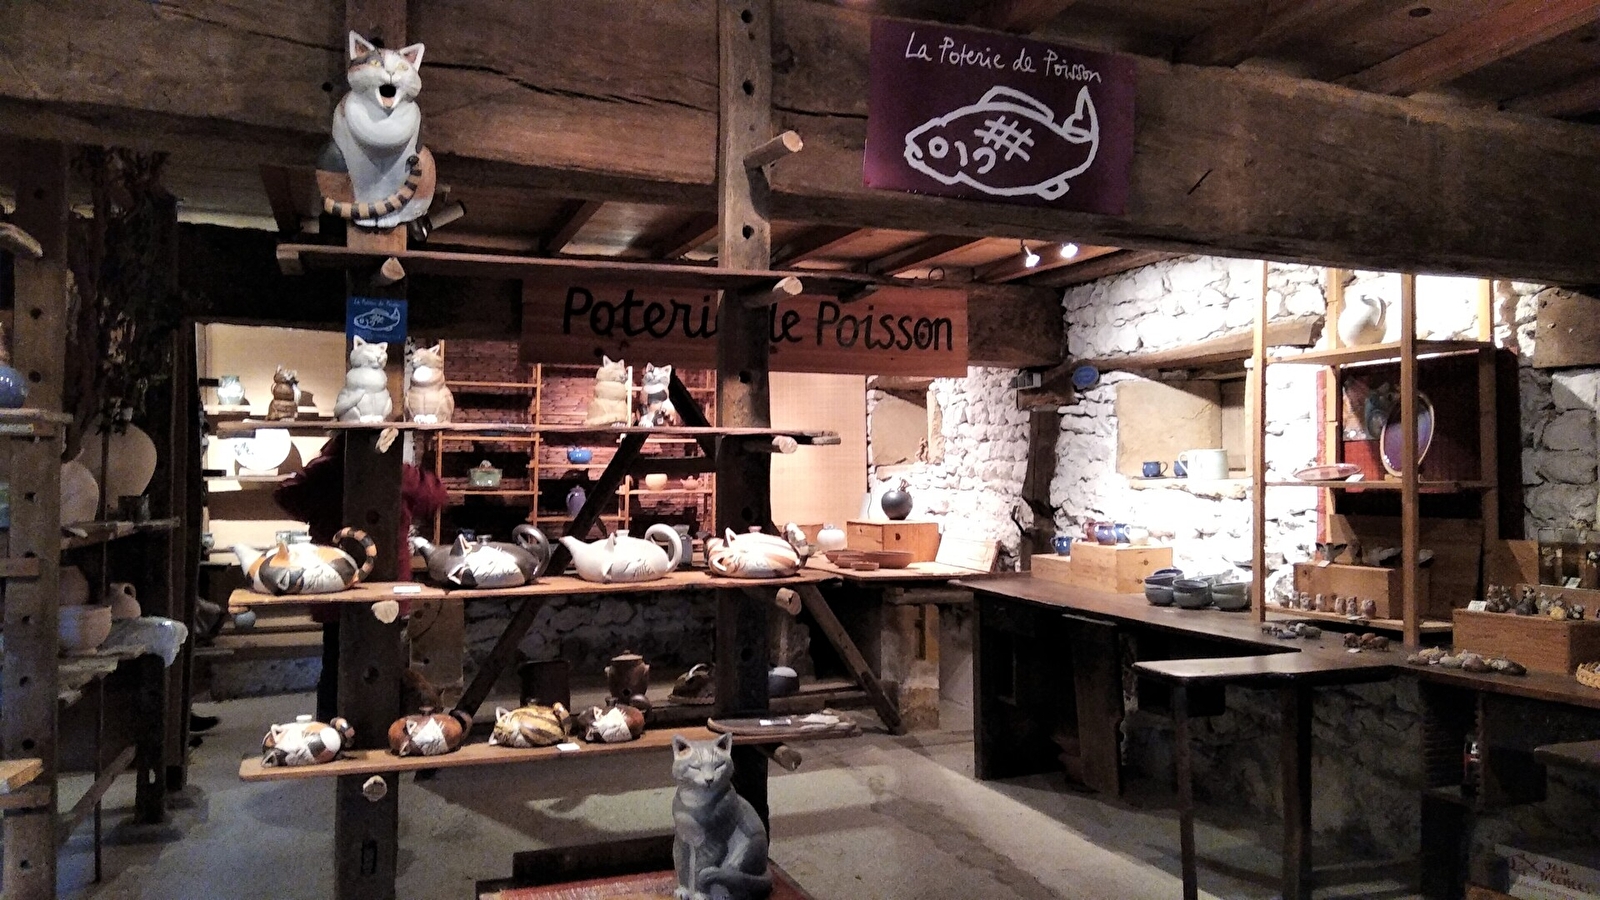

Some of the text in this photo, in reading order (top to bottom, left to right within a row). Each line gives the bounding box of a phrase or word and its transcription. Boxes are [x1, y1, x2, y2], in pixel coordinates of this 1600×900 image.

[905, 31, 1101, 83] La Poterie de Poisson
[563, 286, 718, 339] Poteri
[816, 301, 953, 351] Poisson
